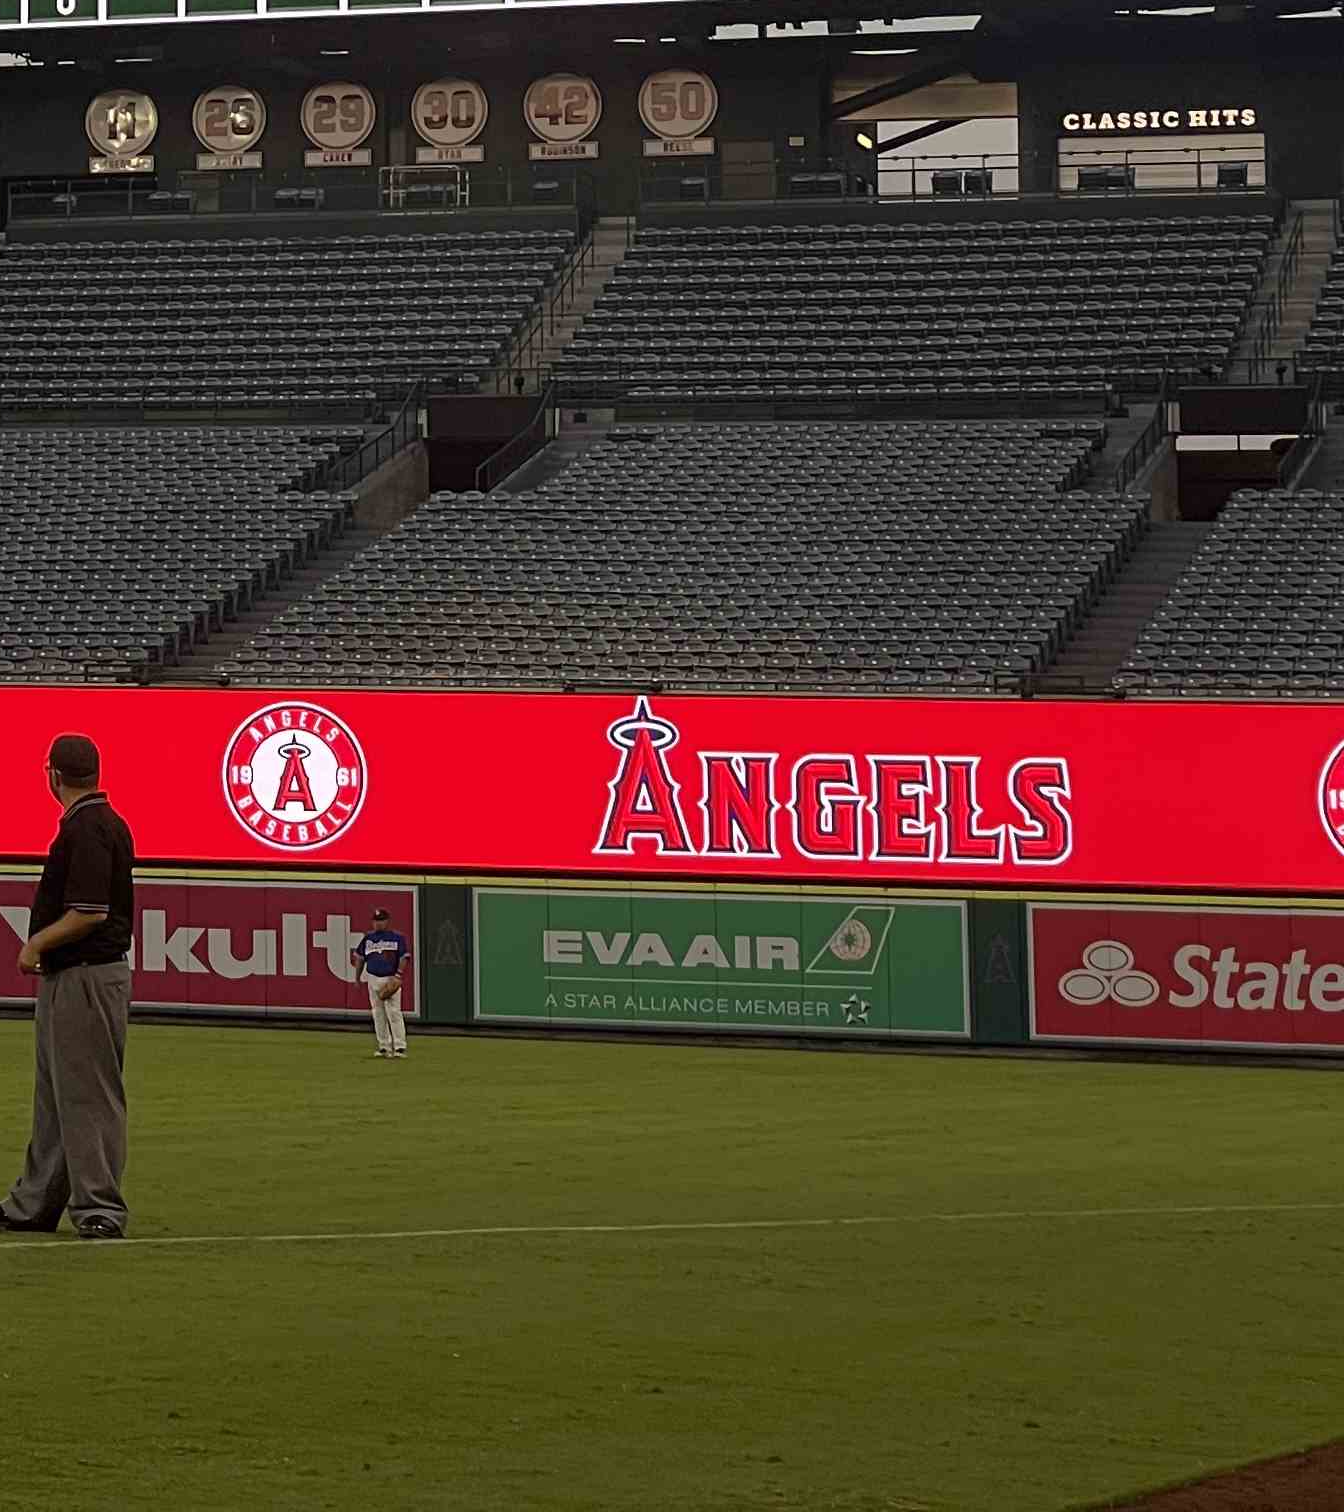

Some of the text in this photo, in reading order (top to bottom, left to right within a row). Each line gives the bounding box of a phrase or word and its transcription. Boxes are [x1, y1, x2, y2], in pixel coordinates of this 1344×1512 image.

[312, 94, 365, 133] 29
[423, 90, 475, 129] 30
[534, 85, 589, 126] 42
[651, 81, 706, 121] 50
[1063, 108, 1257, 131] CLASSIC HITS
[248, 710, 341, 743] ANGELS
[231, 764, 357, 787] 19 61
[236, 794, 354, 841] BASEBALL
[1168, 942, 1344, 1013] State
[544, 992, 830, 1018] A STAR ALLIANCE MEMBER
